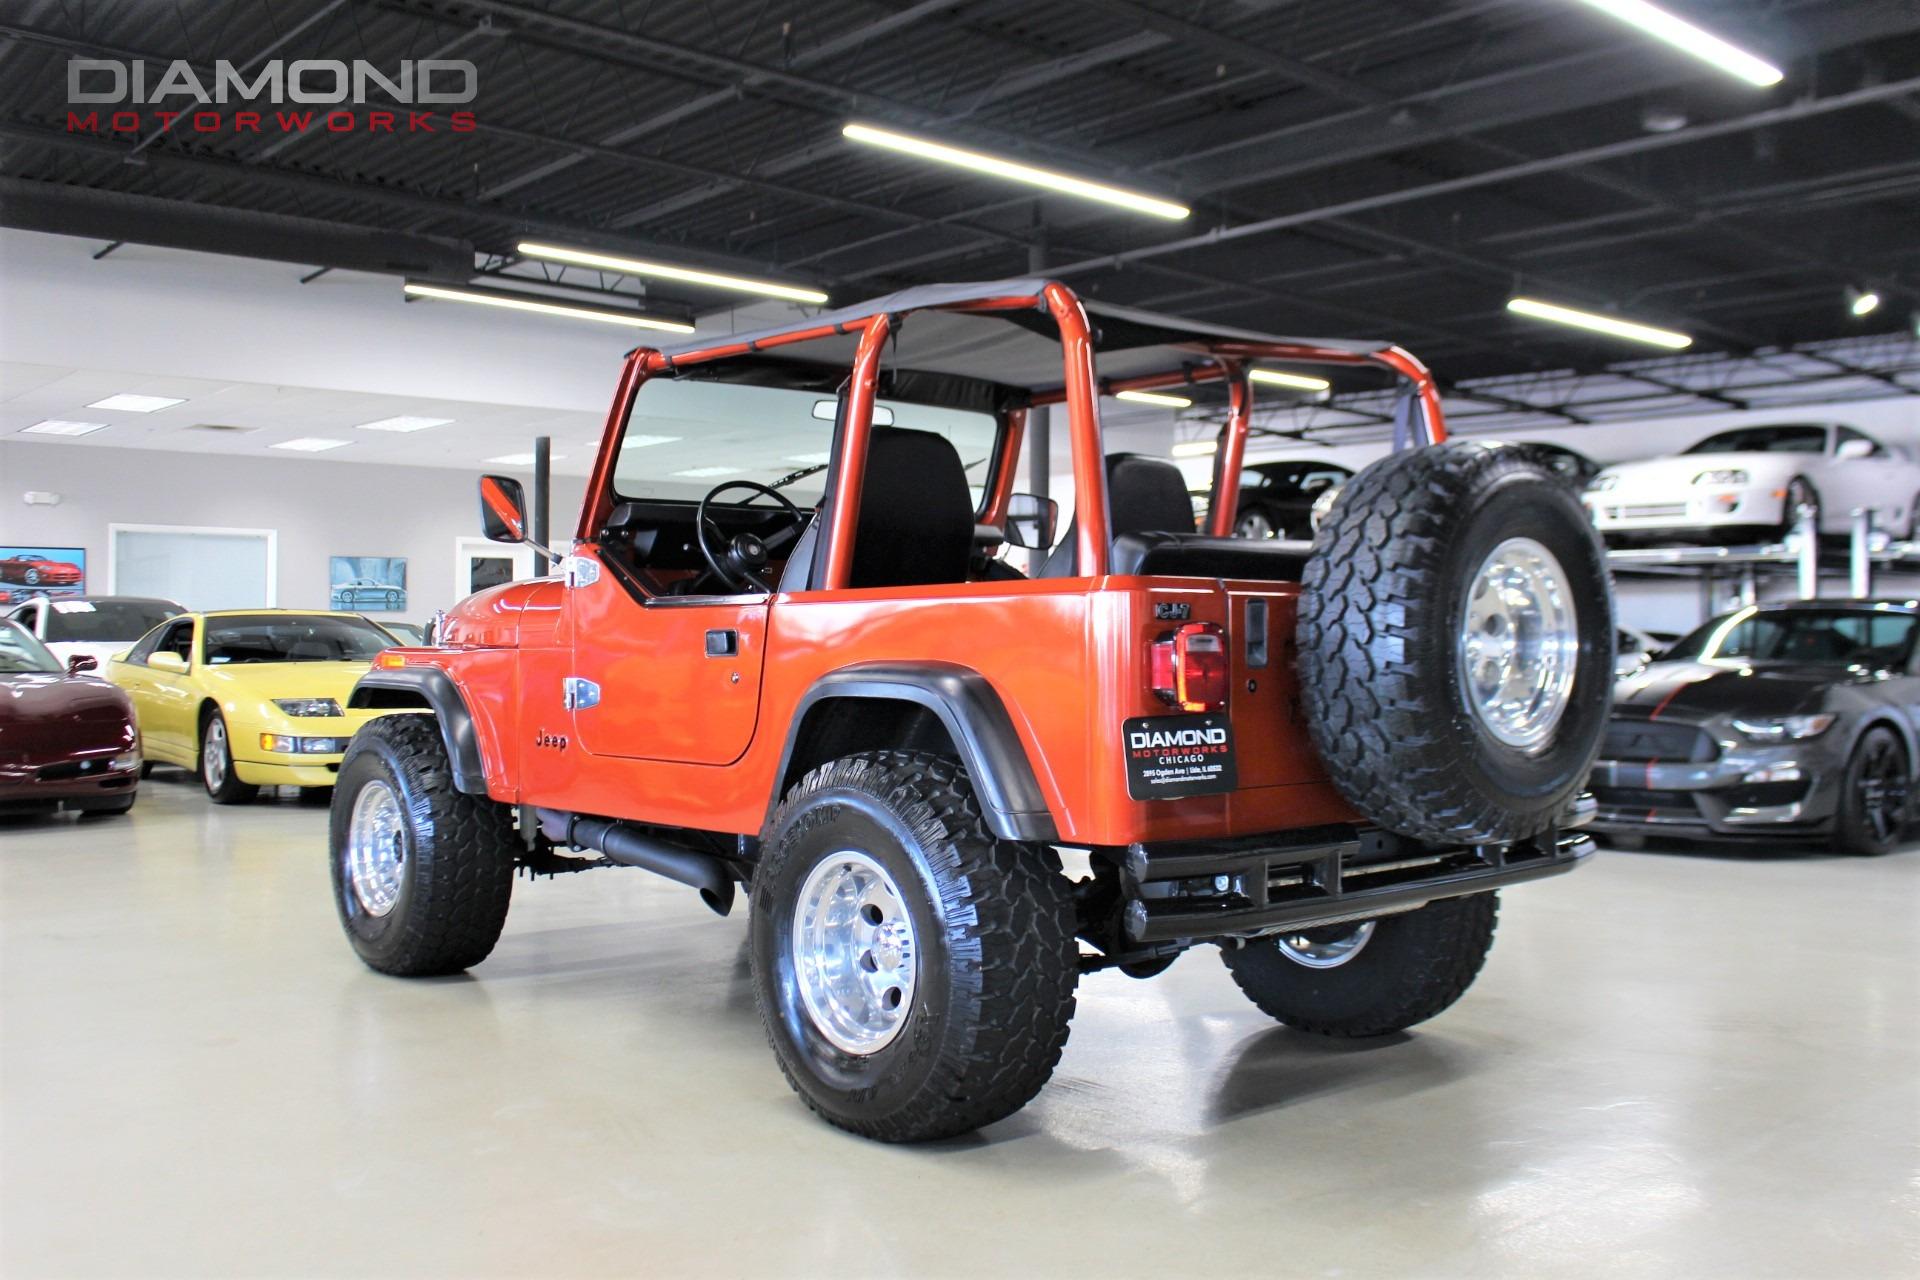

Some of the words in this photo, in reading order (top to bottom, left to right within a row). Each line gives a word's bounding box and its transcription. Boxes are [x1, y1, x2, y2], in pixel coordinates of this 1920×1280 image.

[1156, 602, 1190, 619] CJ-7
[536, 729, 567, 752] Jeep
[1130, 728, 1227, 749] DIAMOND
[1132, 745, 1229, 758] MOTORWORKS
[1158, 754, 1205, 765] CHICAGO
